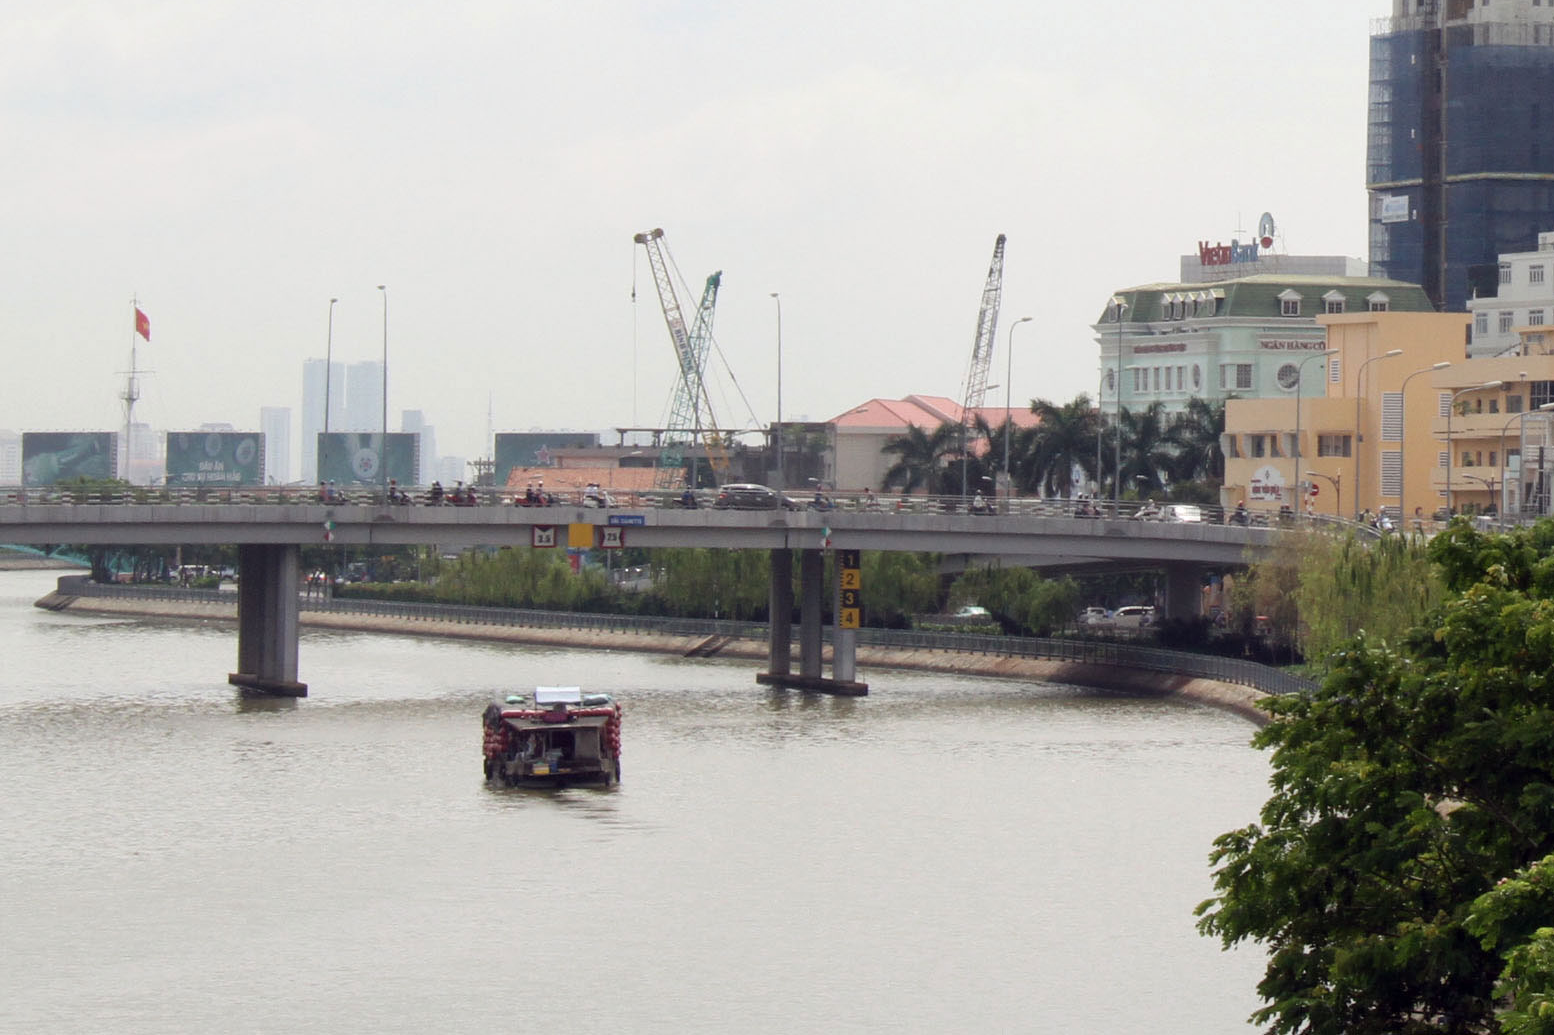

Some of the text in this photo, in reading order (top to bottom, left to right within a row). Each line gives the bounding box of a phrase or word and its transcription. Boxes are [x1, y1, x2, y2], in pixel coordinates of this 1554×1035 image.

[846, 572, 855, 585] 2
[845, 592, 854, 605] 3
[846, 611, 854, 624] 4
